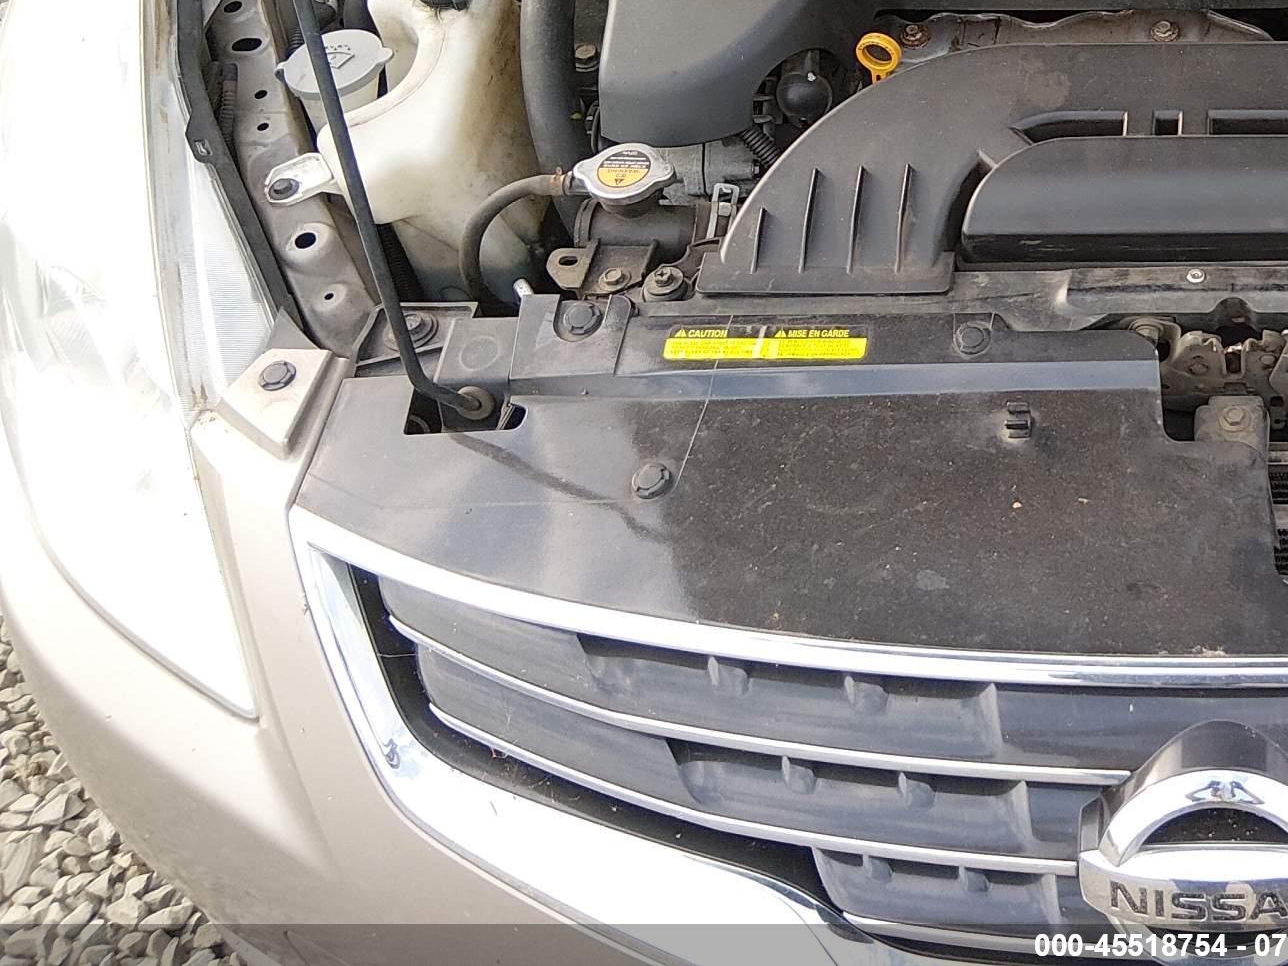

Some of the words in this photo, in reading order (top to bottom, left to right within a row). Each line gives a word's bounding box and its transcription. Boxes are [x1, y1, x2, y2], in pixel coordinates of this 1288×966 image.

[687, 329, 729, 338] CAUTION
[787, 329, 808, 338] MISE
[808, 329, 821, 338] EN
[821, 329, 850, 338] GARDE
